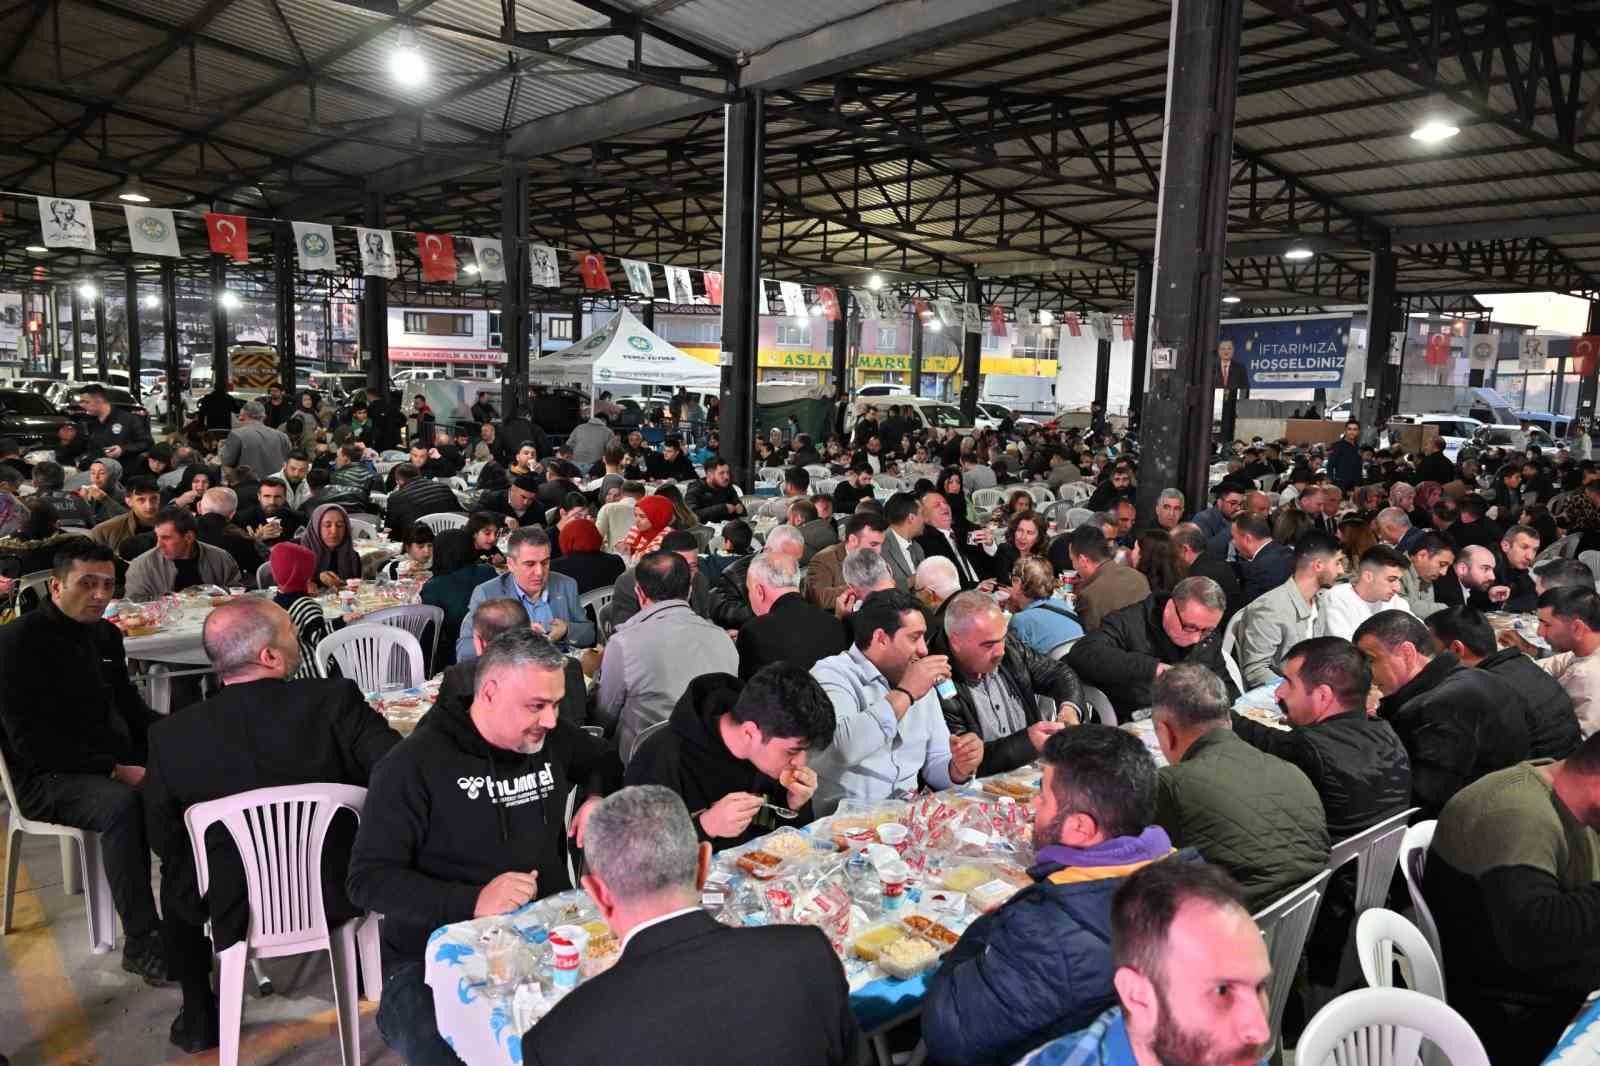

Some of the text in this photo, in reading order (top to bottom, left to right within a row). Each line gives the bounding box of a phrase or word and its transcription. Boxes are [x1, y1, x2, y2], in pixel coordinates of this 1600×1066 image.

[1258, 341, 1337, 354] İFTARIMIZA
[784, 353, 831, 367] ASLA
[1250, 356, 1345, 370] HOŞGELDİNİZ
